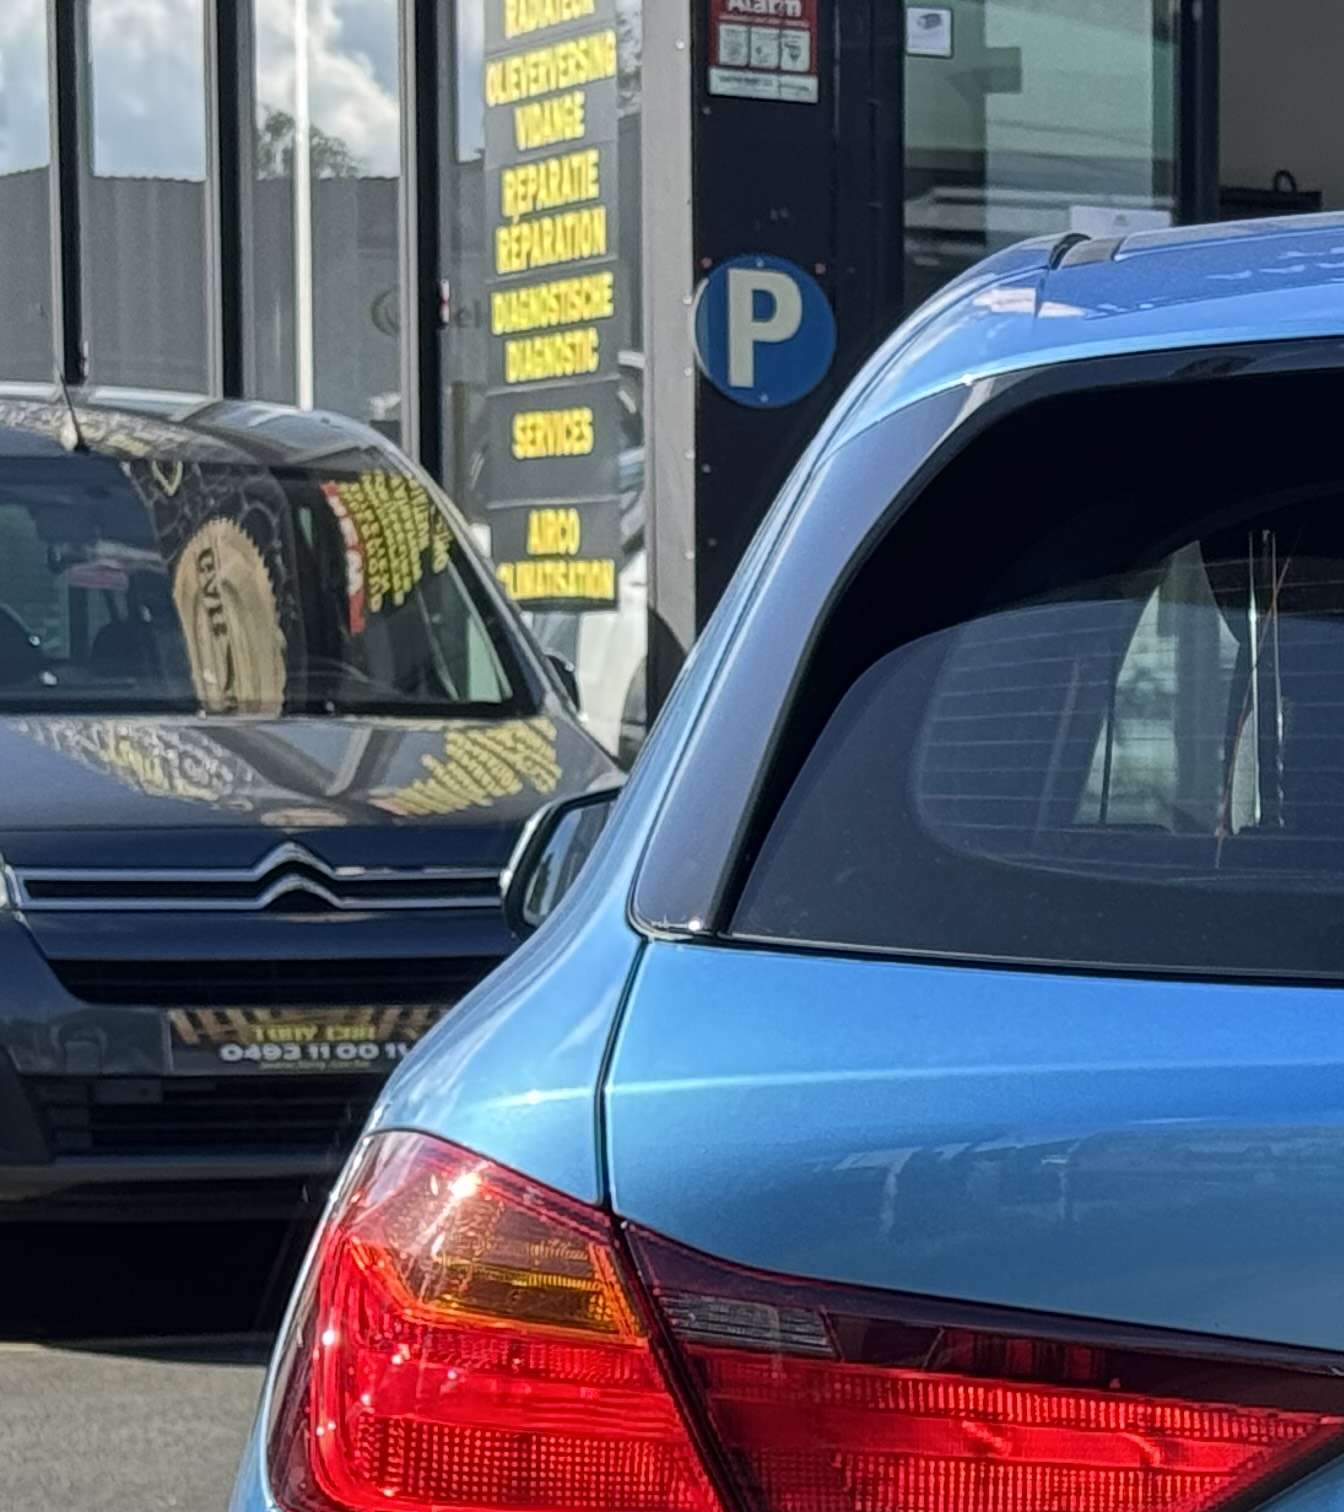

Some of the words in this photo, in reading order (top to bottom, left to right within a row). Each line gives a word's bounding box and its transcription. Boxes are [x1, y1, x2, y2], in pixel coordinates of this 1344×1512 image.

[728, 268, 802, 388] P
[513, 406, 594, 460] SERVICES
[527, 507, 580, 556] AIRCO
[220, 1042, 300, 1061] 0493
[308, 1042, 331, 1060] 11
[335, 1042, 380, 1060] 00
